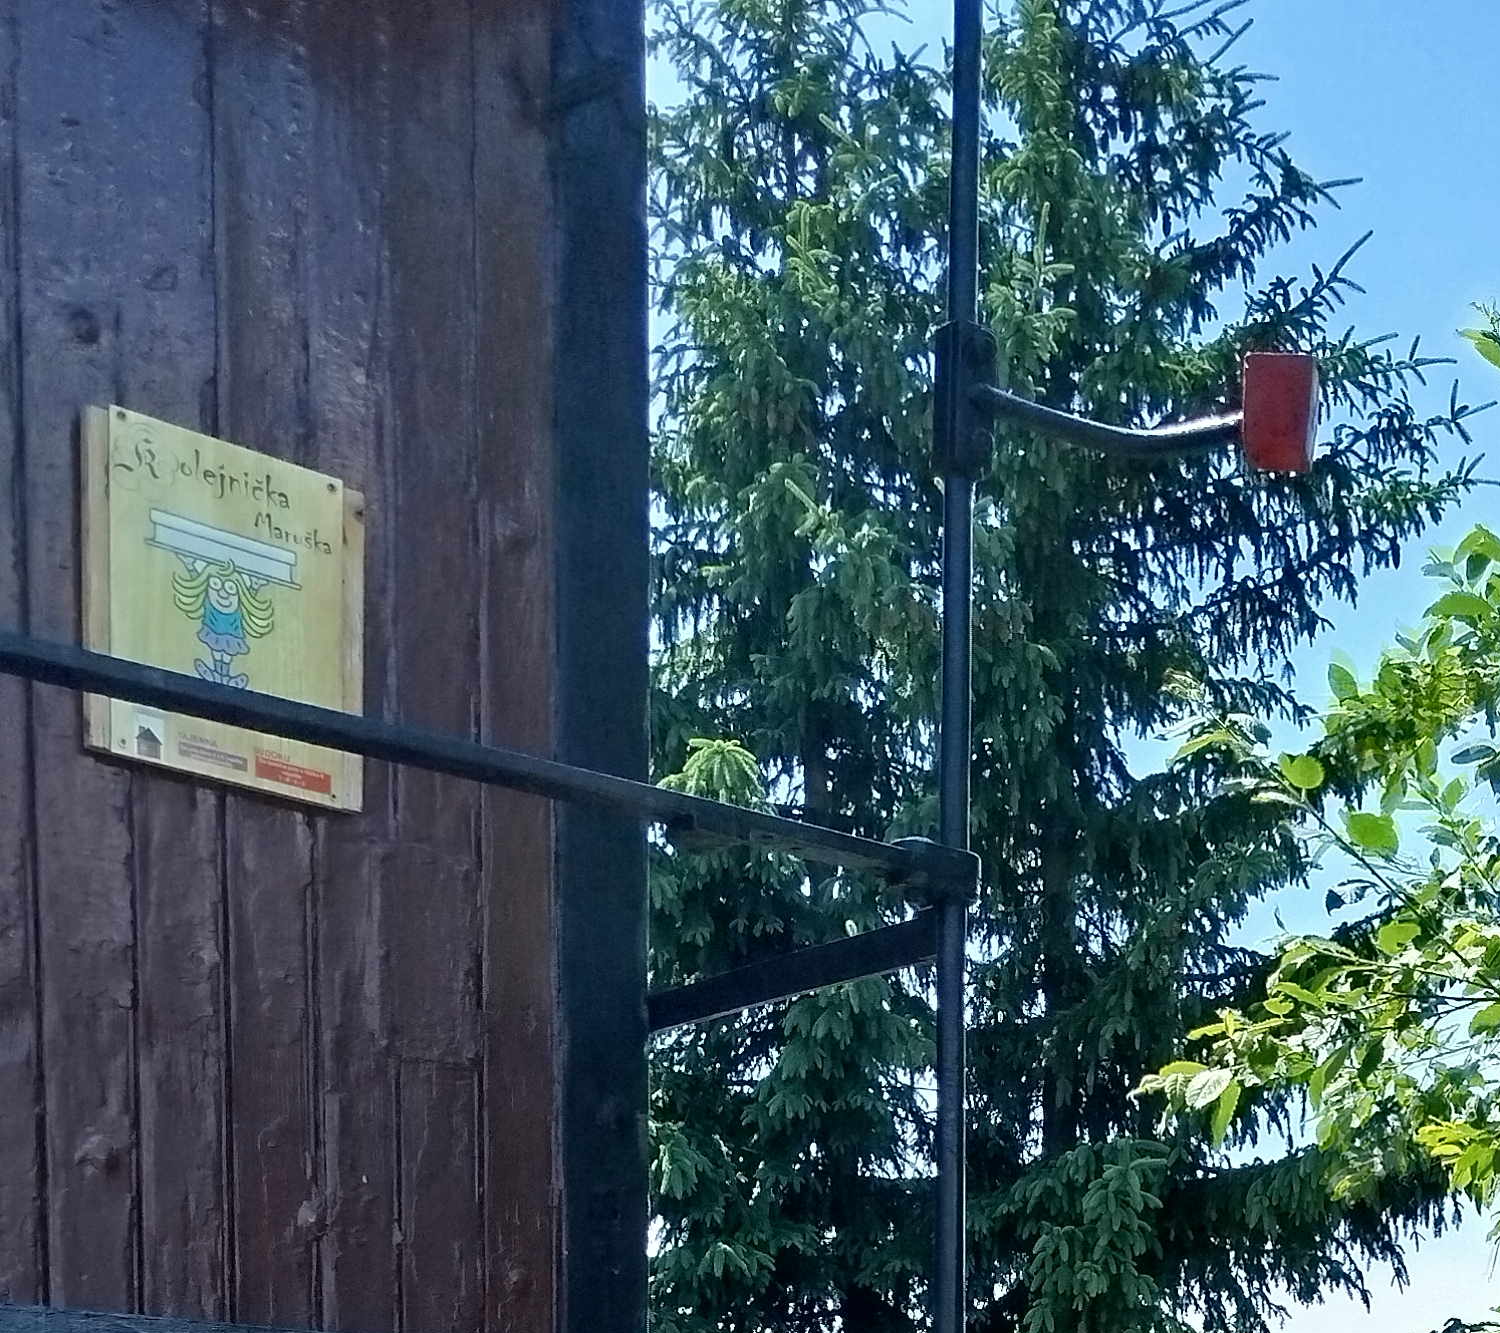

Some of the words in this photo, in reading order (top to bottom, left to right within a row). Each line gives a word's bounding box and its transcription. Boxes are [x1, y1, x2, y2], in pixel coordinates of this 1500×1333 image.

[112, 437, 291, 510] Kolejnička
[254, 511, 332, 555] Maruška
[253, 746, 291, 762] UDOKU
